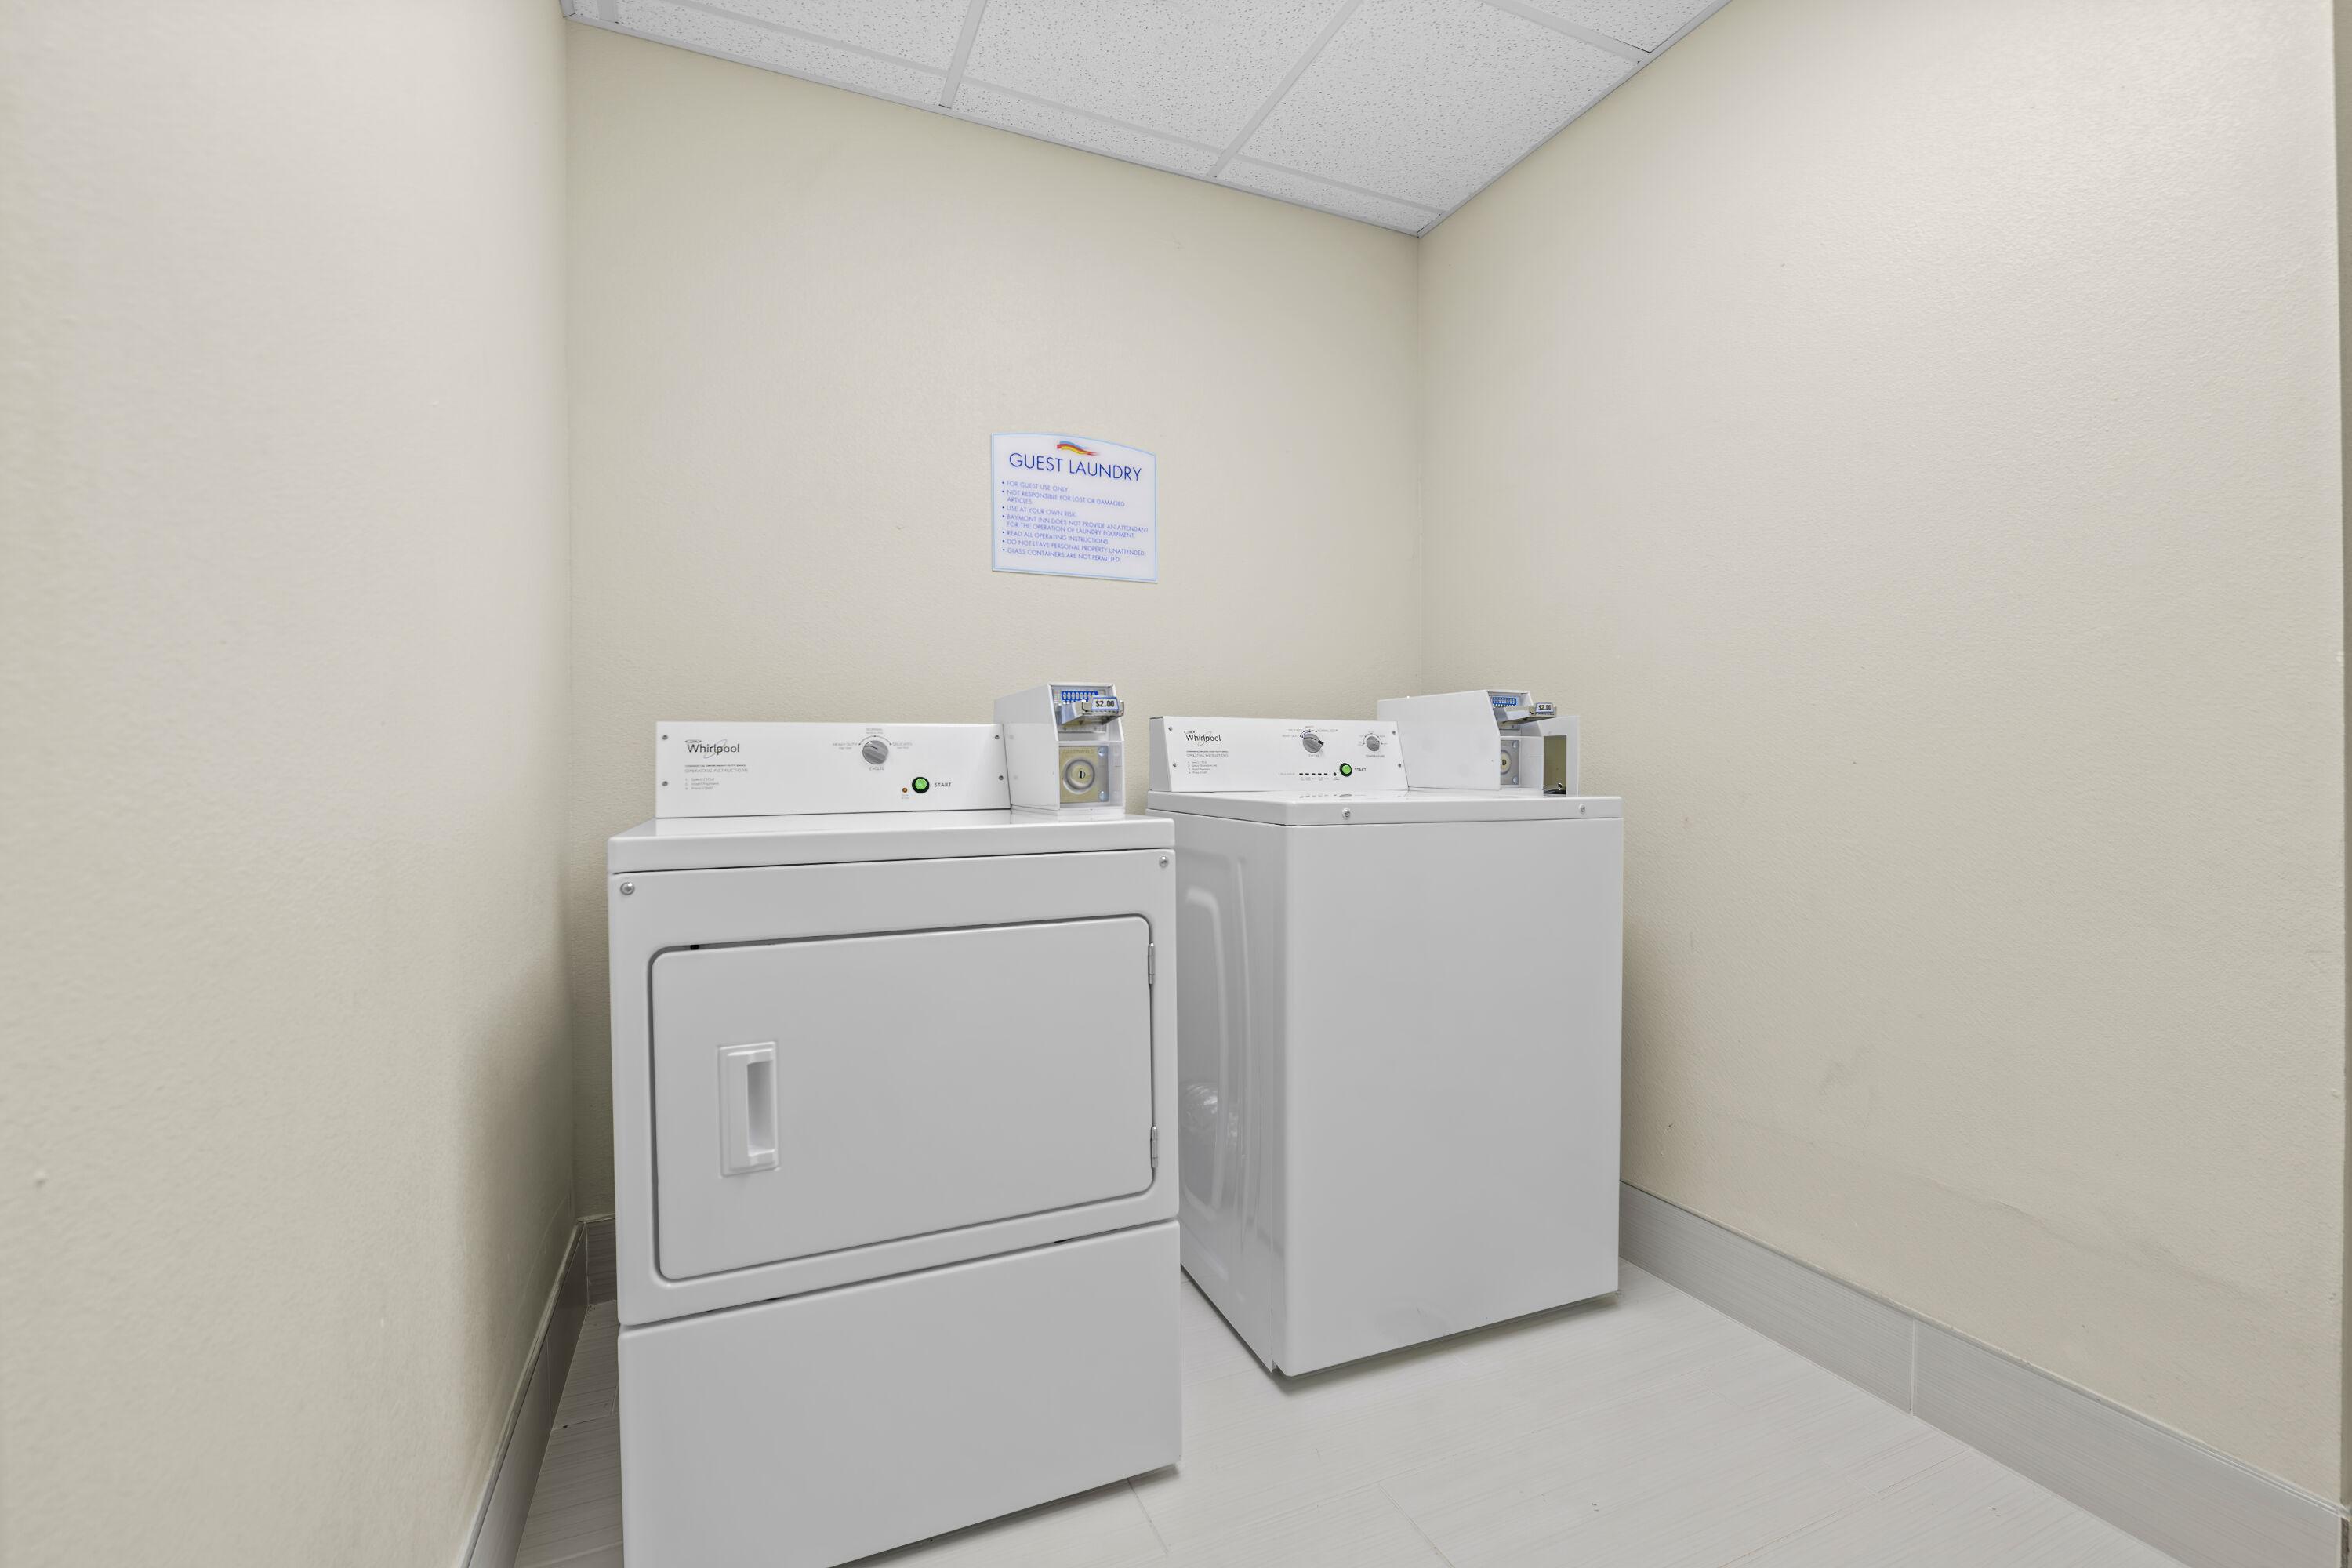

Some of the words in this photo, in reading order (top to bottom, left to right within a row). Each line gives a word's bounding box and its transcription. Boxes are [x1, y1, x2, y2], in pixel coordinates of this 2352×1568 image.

[1009, 452, 1063, 472] GUEST
[1069, 459, 1142, 481] LAUNDRY
[1022, 491, 1058, 500] RESPONSIBLE
[1097, 499, 1125, 507] DAMAGED
[1033, 524, 1065, 532] OPERATION
[1185, 734, 1221, 744] Whirlpool
[687, 743, 740, 756] Whirlpool
